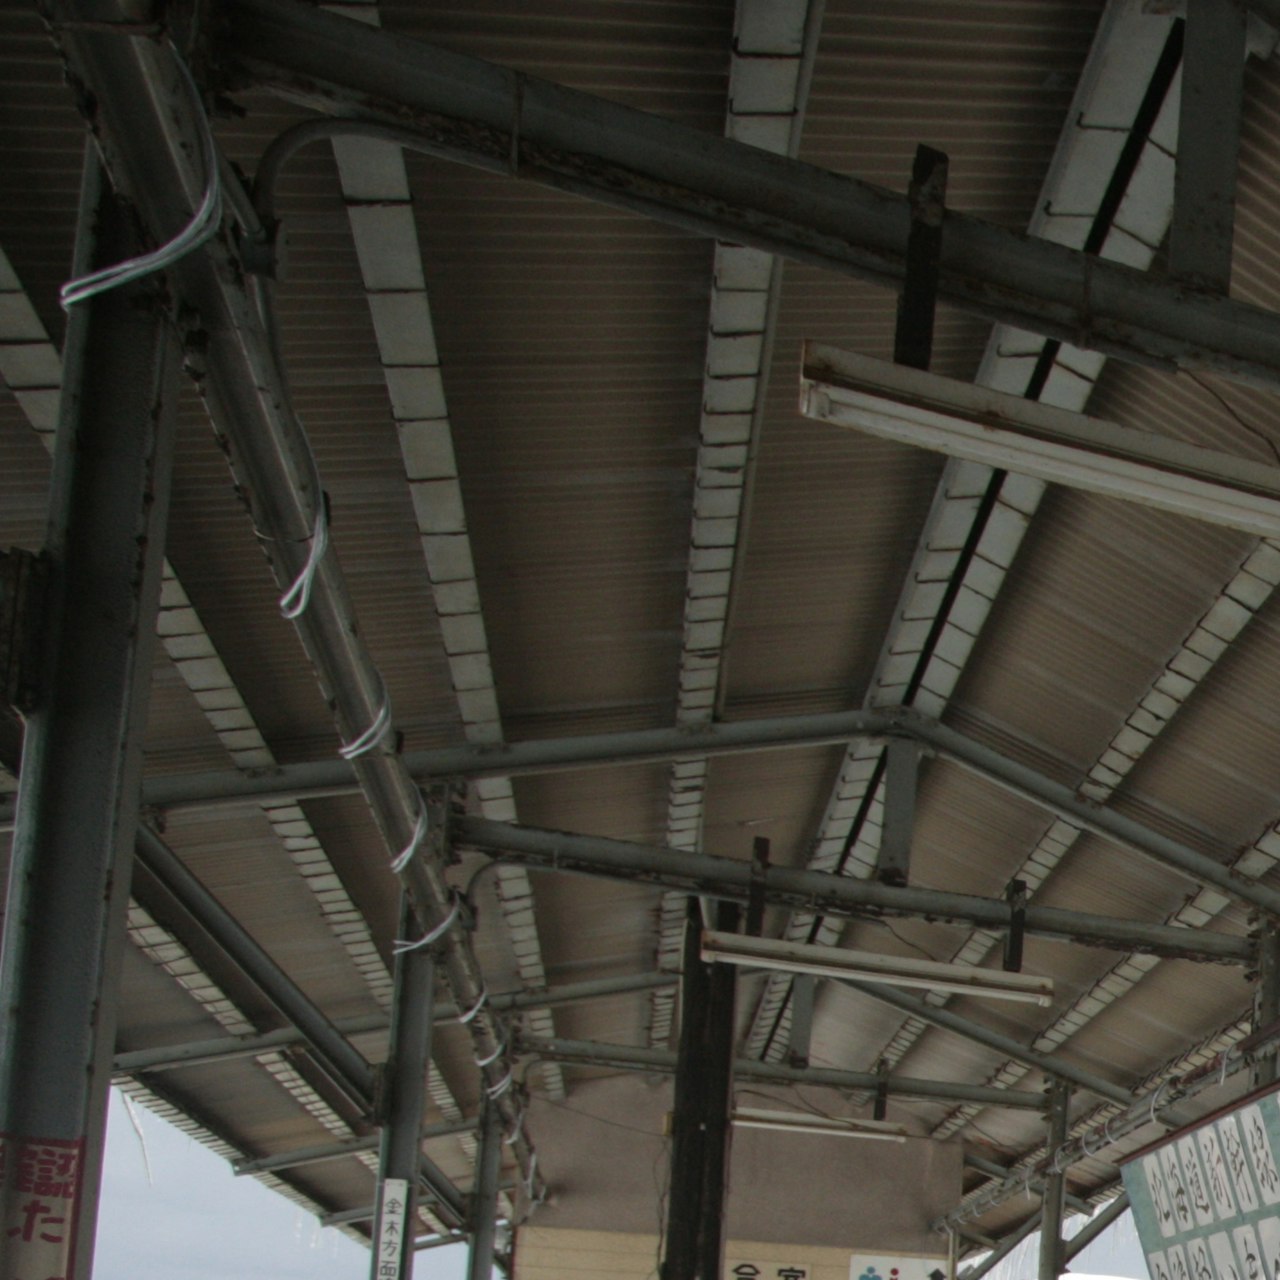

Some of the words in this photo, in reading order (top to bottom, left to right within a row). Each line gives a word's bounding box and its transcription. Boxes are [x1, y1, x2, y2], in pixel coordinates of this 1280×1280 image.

[1151, 1116, 1279, 1224] 北海道新幹線
